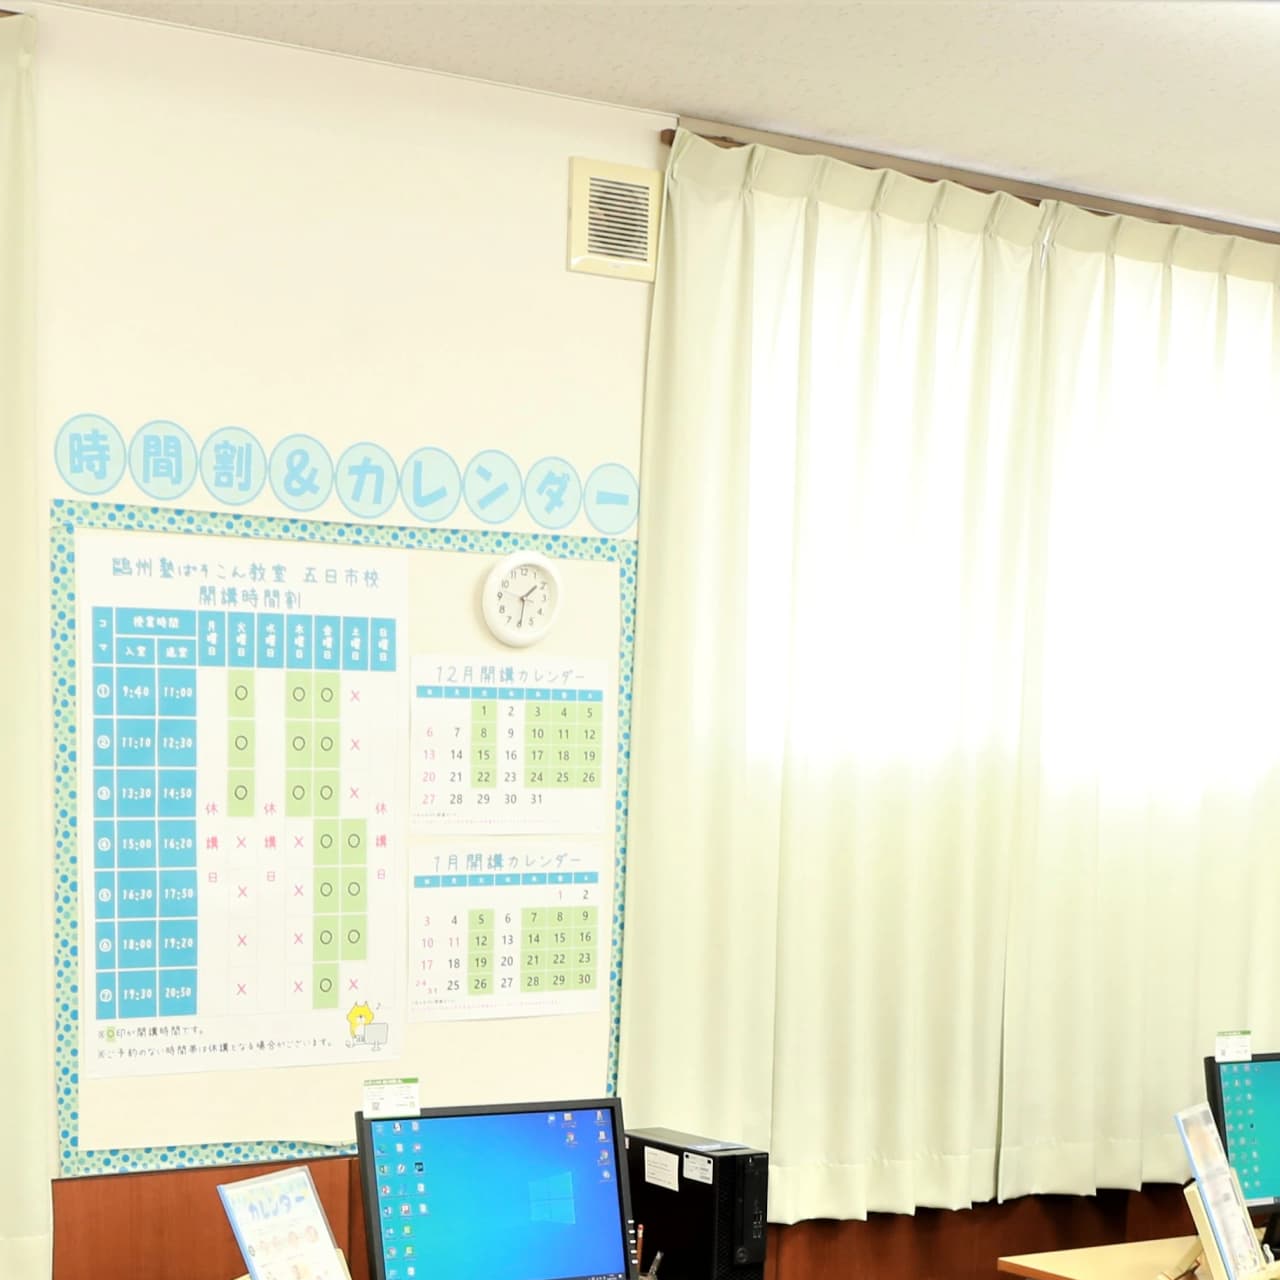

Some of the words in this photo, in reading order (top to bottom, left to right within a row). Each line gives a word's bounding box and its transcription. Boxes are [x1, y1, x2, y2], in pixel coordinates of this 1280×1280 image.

[68, 430, 629, 514] 時間割&カレンダー
[437, 665, 585, 684] 12月開講カレンダー
[122, 685, 149, 697] 9:40
[163, 687, 193, 699] 11:00
[532, 727, 545, 739] 10
[558, 728, 569, 740] 11
[584, 729, 596, 740] 12
[121, 736, 151, 749] 11:10
[163, 737, 193, 749] 12:30
[423, 749, 436, 761] 13
[450, 749, 463, 760] 14
[477, 749, 490, 761] 15
[505, 749, 518, 761] 16
[532, 749, 544, 761] 17
[558, 750, 570, 761] 18
[583, 750, 596, 761] 19
[423, 769, 437, 783] 20
[449, 771, 462, 783] 21
[477, 771, 490, 783] 22
[504, 771, 517, 783] 23
[530, 771, 543, 783] 24
[556, 771, 569, 783] 25
[582, 772, 596, 784] 26
[122, 787, 151, 799] 13:30
[163, 787, 192, 800] 14:50
[421, 793, 436, 805] 27
[449, 793, 463, 805] 28
[477, 793, 491, 805] 29
[505, 793, 518, 805] 30
[531, 793, 542, 805] 31
[122, 838, 152, 850] 15:00
[163, 837, 193, 849] 16:20
[122, 889, 152, 900] 16:30
[164, 888, 194, 899] 17:50
[123, 939, 152, 950] 18:00
[164, 938, 193, 949] 19:20
[422, 937, 434, 949] 10
[448, 936, 460, 948] 11
[475, 935, 488, 947] 12
[502, 934, 514, 945] 13
[528, 933, 540, 944] 14
[554, 932, 566, 943] 15
[580, 931, 592, 942] 16
[421, 959, 433, 971] 17
[448, 958, 461, 969] 18
[475, 957, 487, 968] 19
[501, 955, 513, 967] 20
[527, 954, 539, 966] 21
[552, 953, 566, 965] 22
[578, 952, 591, 964] 23
[447, 979, 460, 991] 25
[474, 978, 487, 990] 26
[500, 977, 513, 989] 27
[526, 976, 540, 987] 28
[552, 975, 566, 986] 29
[578, 973, 591, 985] 30
[123, 989, 152, 1000] 19:30
[165, 987, 192, 999] 20:50
